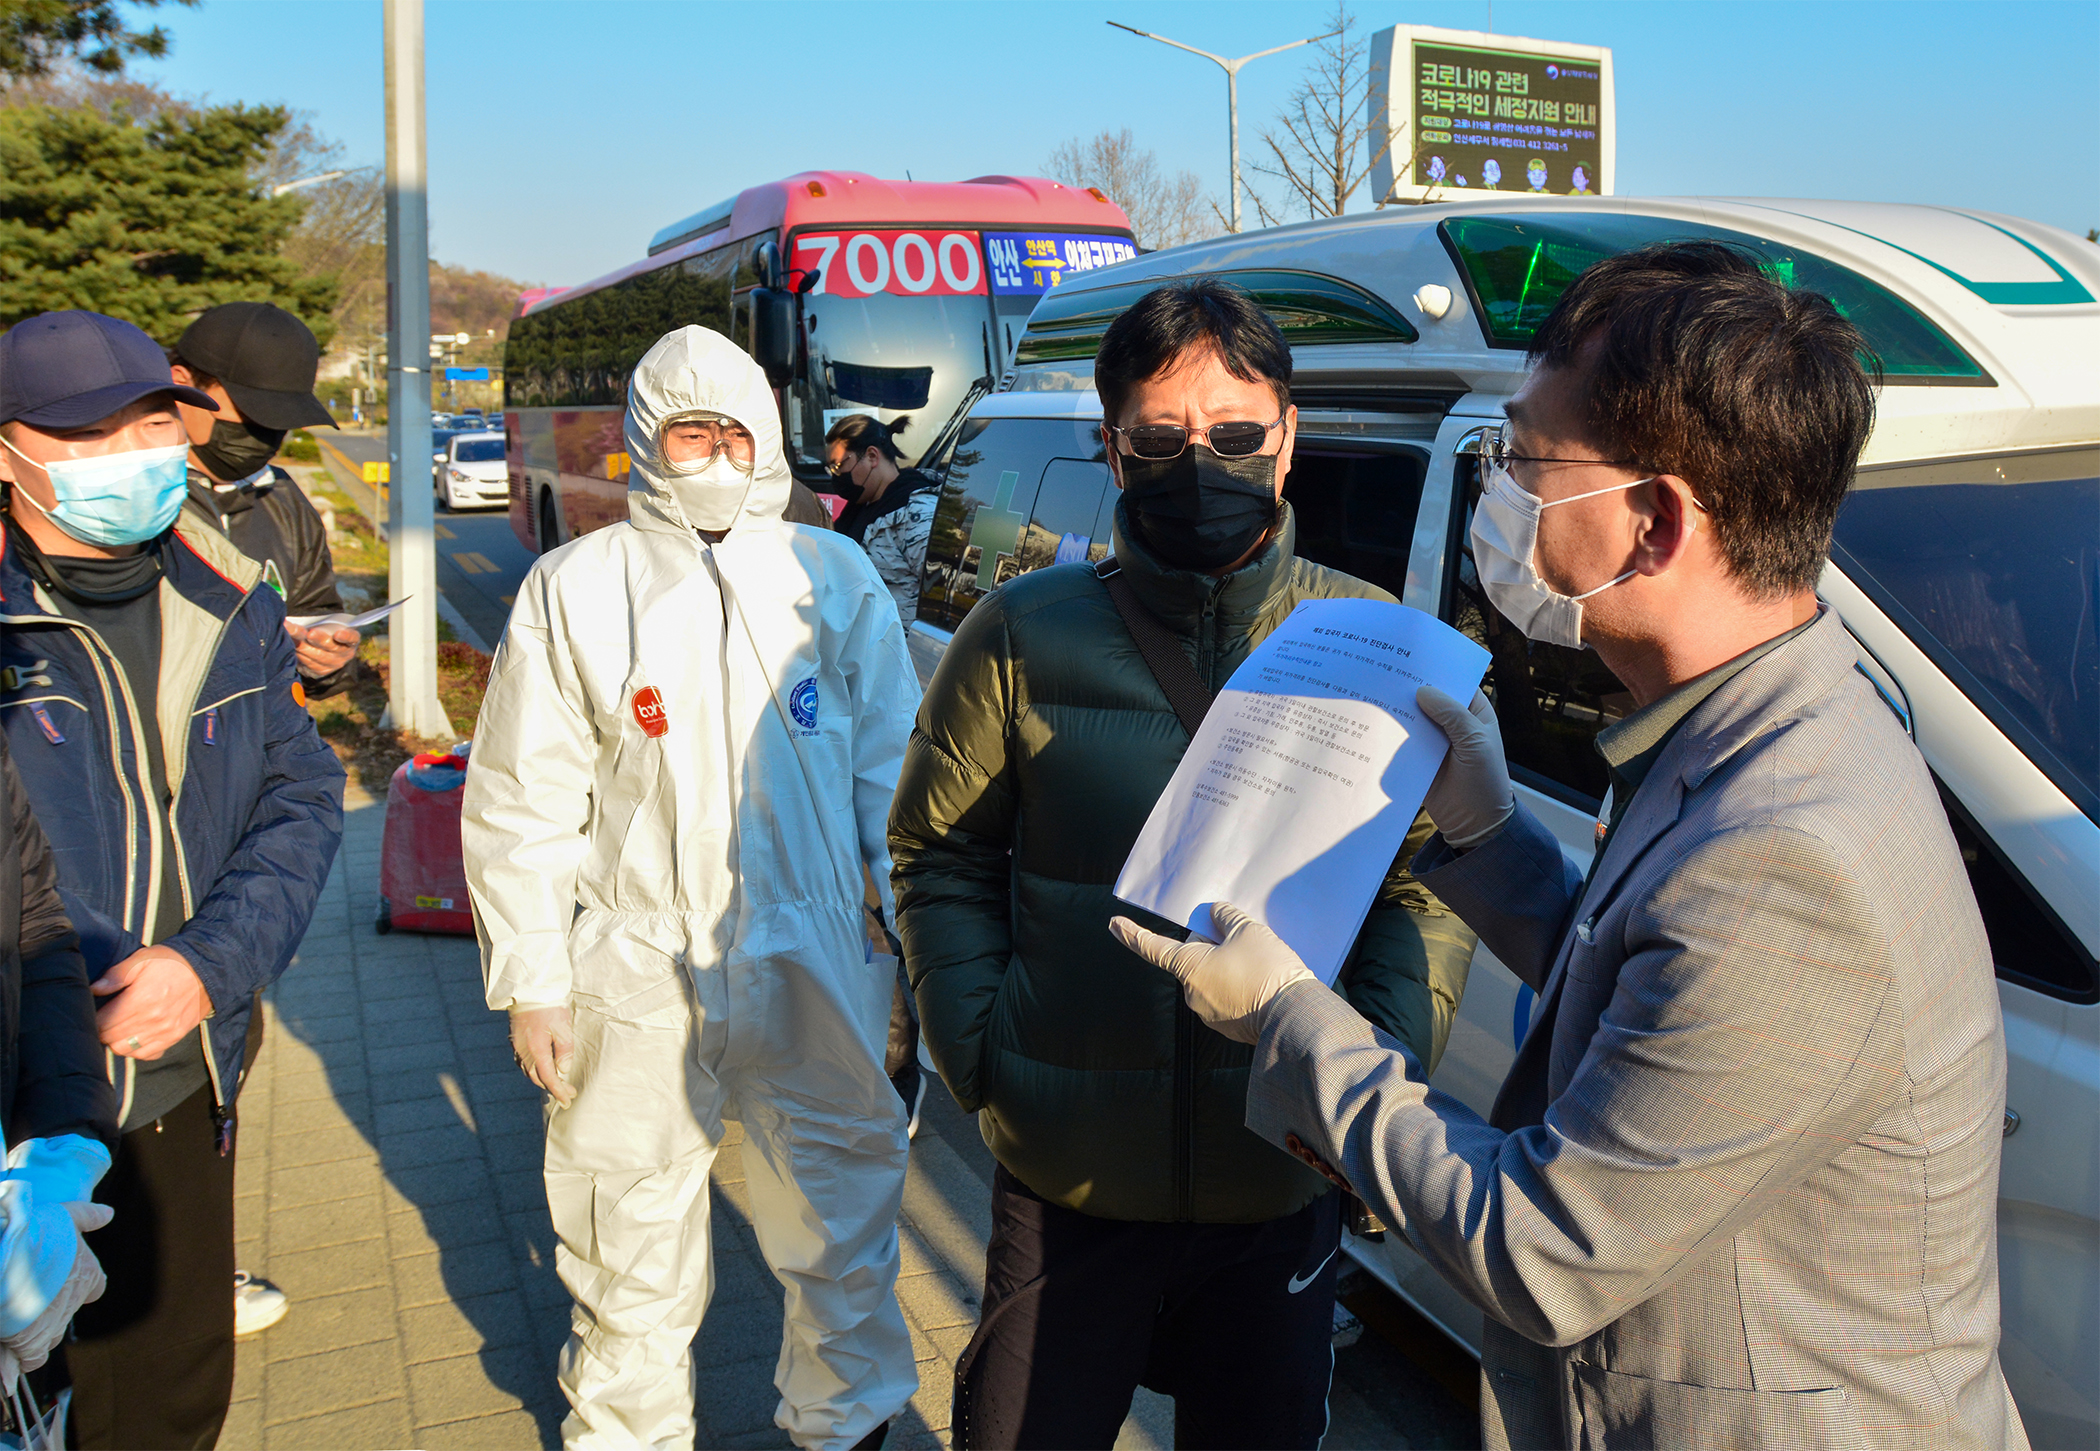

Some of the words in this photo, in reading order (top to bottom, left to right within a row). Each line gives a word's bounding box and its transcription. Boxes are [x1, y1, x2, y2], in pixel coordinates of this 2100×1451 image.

[1420, 63, 1491, 90] 코로나19
[1495, 70, 1529, 95] 관련
[1421, 88, 1489, 116] 적극적인
[1494, 95, 1560, 122] 세정지원
[1564, 102, 1597, 126] 안내
[989, 238, 1022, 286] 안산
[1026, 240, 1057, 256] 안산역
[797, 233, 980, 296] 7000
[1313, 627, 1324, 635] 해외
[1324, 628, 1341, 637] 입국자
[1342, 632, 1368, 644] 코로나-19
[1370, 638, 1395, 652] 진단검사
[1396, 647, 1411, 658] 안내
[1308, 705, 1337, 719] 관할보건소로
[1338, 715, 1350, 724] 문의
[1358, 723, 1370, 732] 방문
[1332, 685, 1348, 694] 다음과
[1392, 707, 1415, 722] 숙지하시
[1329, 723, 1349, 733] 보건소로
[1351, 730, 1363, 739] 문의
[1325, 741, 1357, 757] 관할보건소로
[1358, 753, 1371, 763] 문의
[1243, 778, 1263, 790] 보건소로
[1264, 787, 1277, 797] 문의
